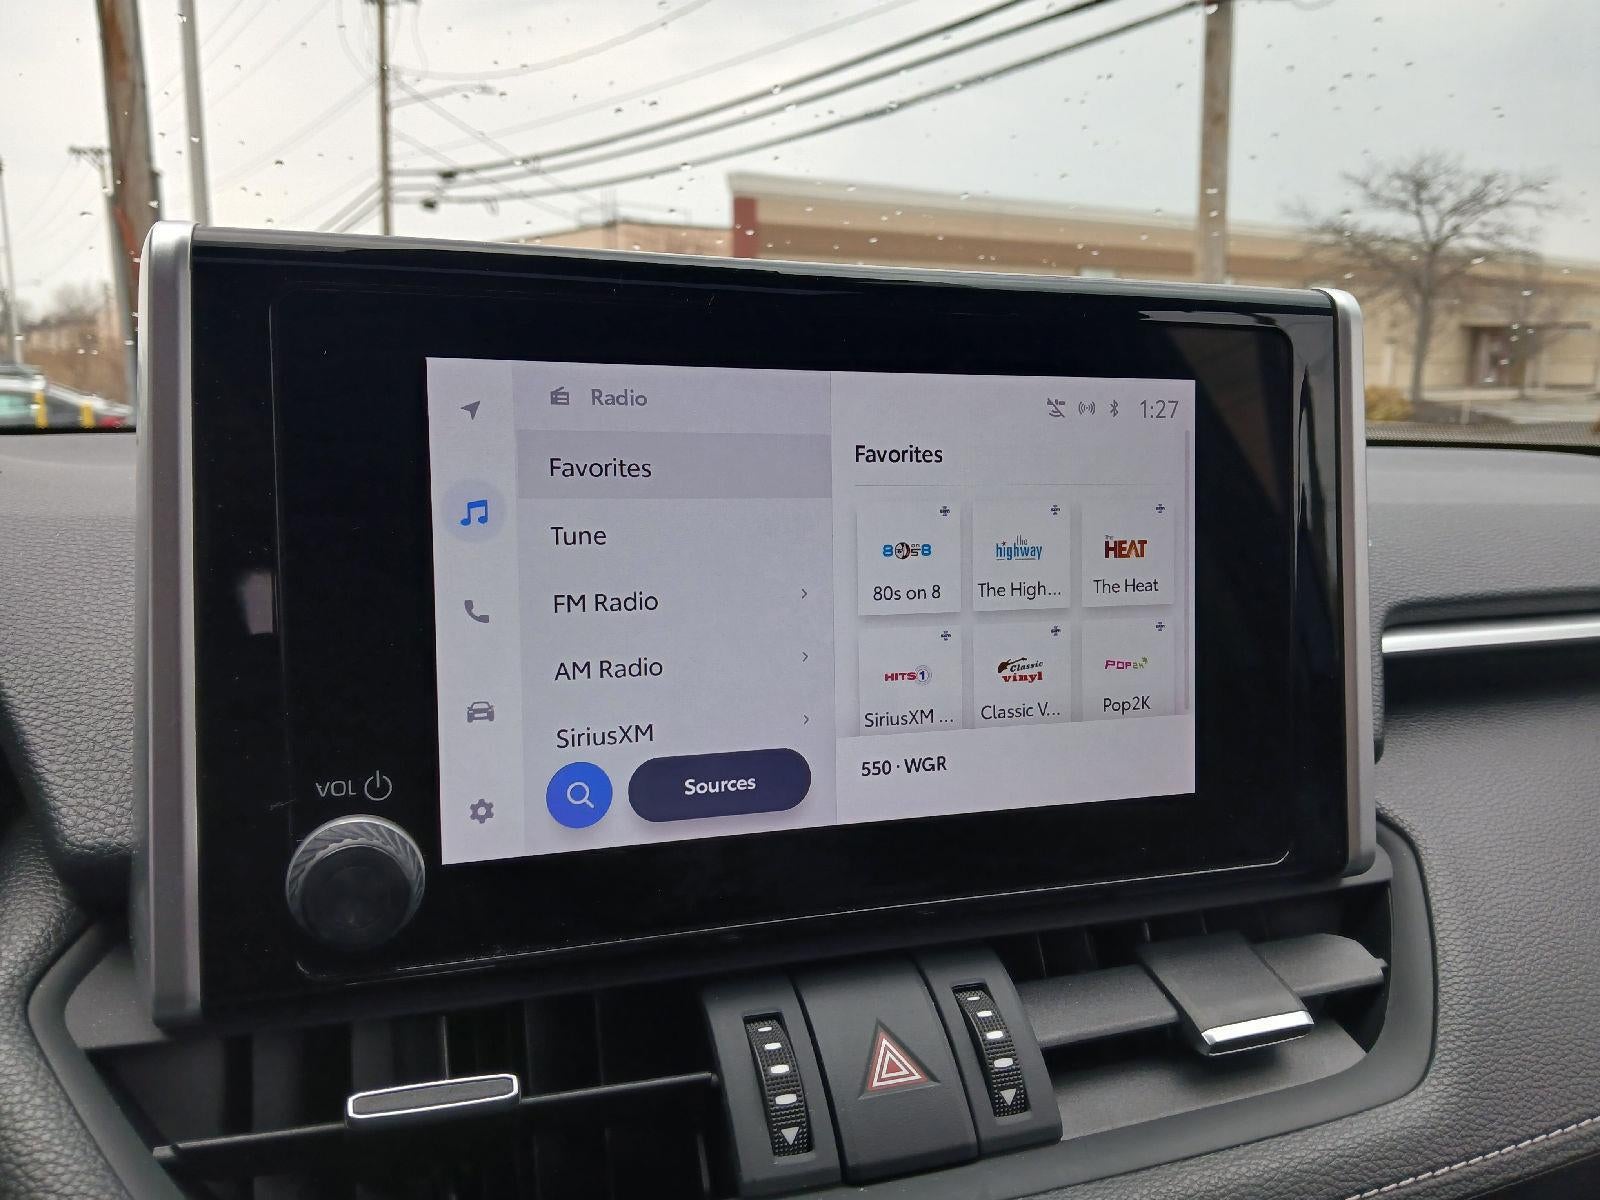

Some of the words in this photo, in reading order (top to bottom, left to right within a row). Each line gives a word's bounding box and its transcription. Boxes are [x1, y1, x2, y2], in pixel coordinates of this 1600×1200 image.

[591, 388, 648, 407] Radio
[1139, 400, 1179, 419] 1:27
[855, 444, 943, 464] Favorites
[549, 457, 652, 478] Favorites
[550, 527, 607, 546] Tune
[996, 541, 1043, 561] highway
[1104, 539, 1148, 559] HEAT
[873, 585, 902, 601] 80s
[906, 588, 927, 600] on
[931, 584, 941, 599] 8
[977, 581, 1006, 598] The
[1093, 578, 1121, 594] The
[1124, 578, 1159, 593] Heat
[553, 594, 586, 614] FM
[594, 590, 659, 612] Radio
[554, 661, 591, 681] AM
[599, 657, 663, 680] Radio
[1009, 660, 1044, 673] Classic
[884, 671, 917, 682] HITS
[1001, 671, 1043, 684] vinyl
[980, 703, 1034, 720] Classic
[1103, 695, 1151, 716] Pop2K
[864, 708, 934, 728] SiriusXM
[556, 723, 655, 749] SiriusXM
[904, 756, 947, 774] WGR
[315, 779, 357, 798] VOL
[684, 775, 757, 796] Sources
